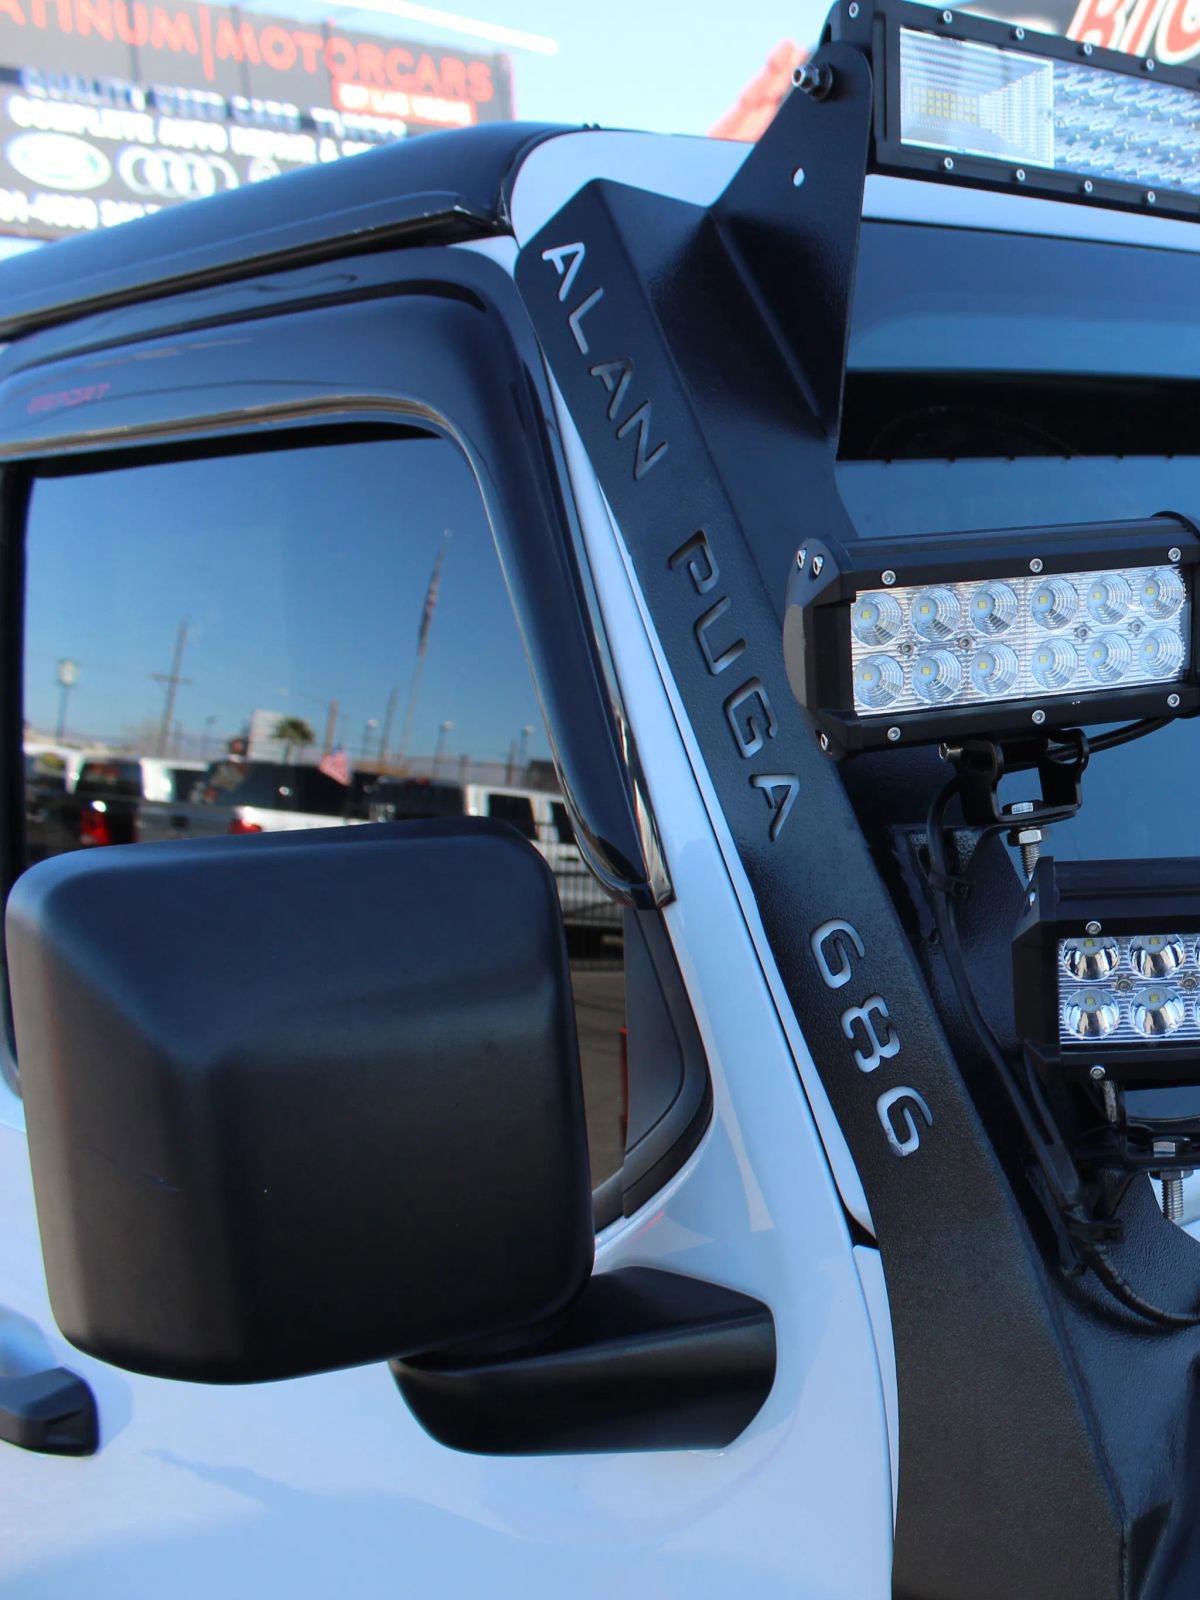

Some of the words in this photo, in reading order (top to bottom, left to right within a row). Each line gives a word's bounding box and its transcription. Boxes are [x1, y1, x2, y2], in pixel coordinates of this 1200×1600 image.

[0, 0, 199, 56] TINUM
[214, 16, 495, 102] MOTORCARS
[541, 241, 669, 481] ALAN
[668, 529, 801, 842] PUGA
